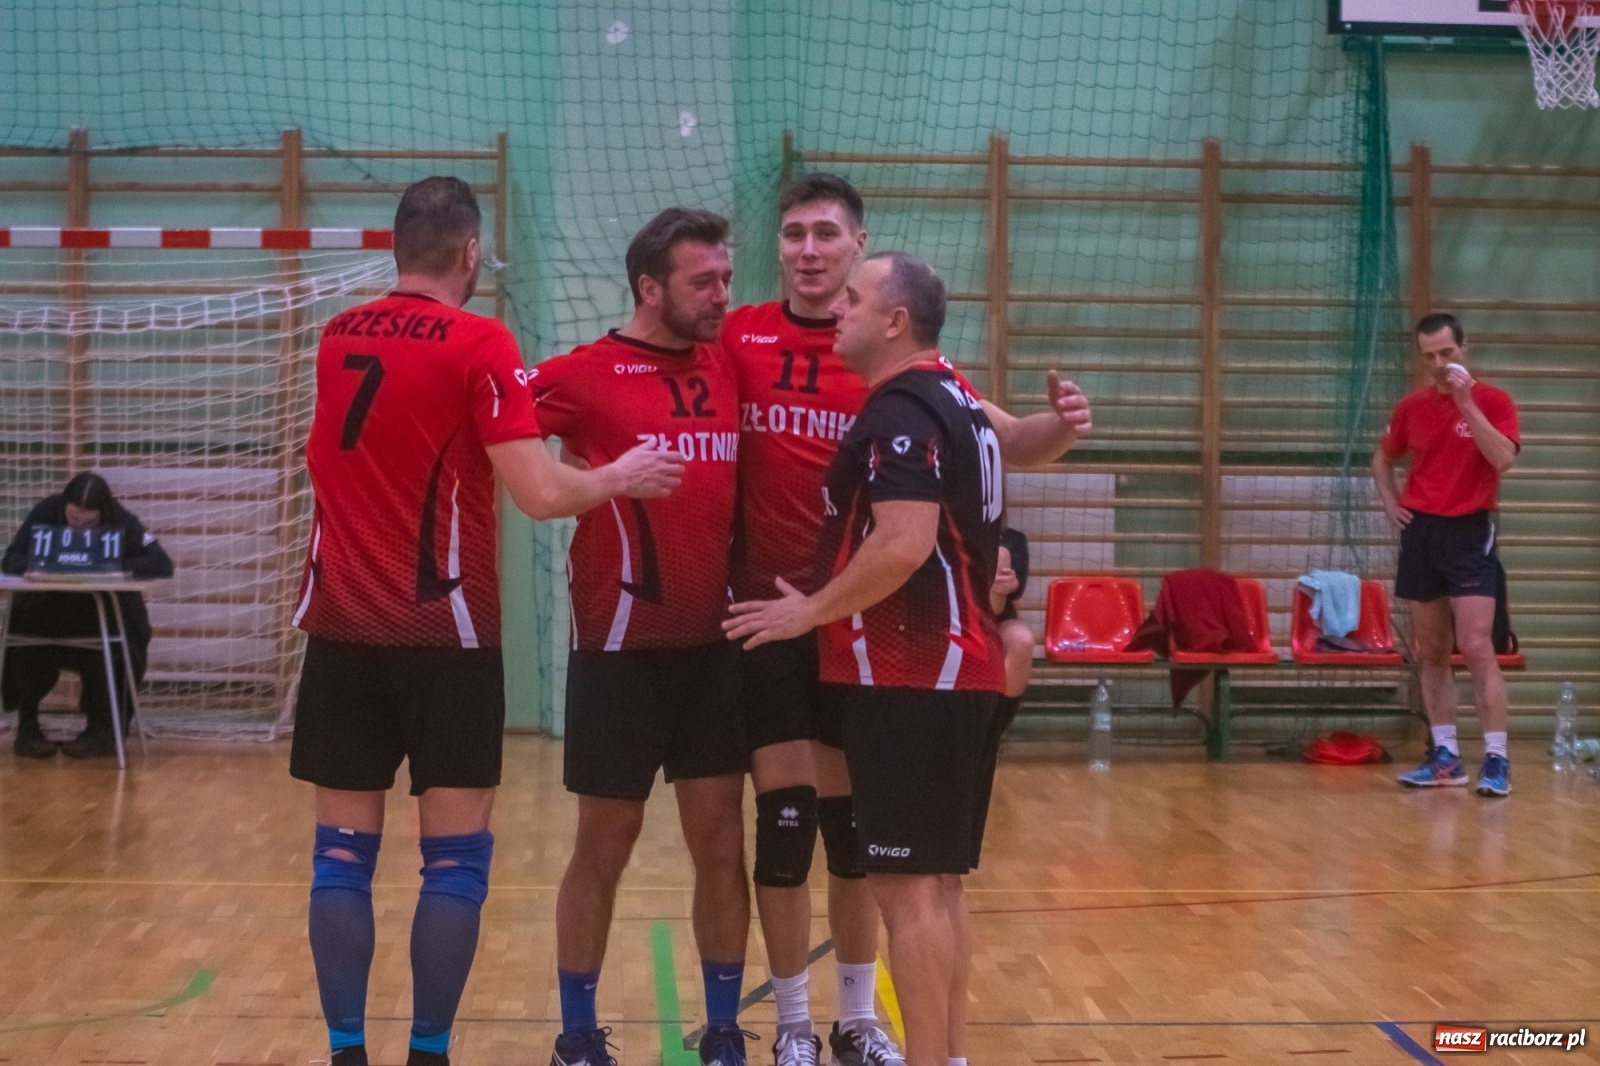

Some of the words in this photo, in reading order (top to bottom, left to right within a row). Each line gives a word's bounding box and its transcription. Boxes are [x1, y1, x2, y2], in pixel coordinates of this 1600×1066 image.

[773, 350, 819, 394] 11
[341, 354, 385, 451] 7
[663, 376, 717, 418] 12
[971, 424, 1003, 524] 10
[33, 530, 52, 557] 11
[62, 529, 72, 547] 0
[83, 529, 91, 547] 1
[101, 531, 119, 558] 11
